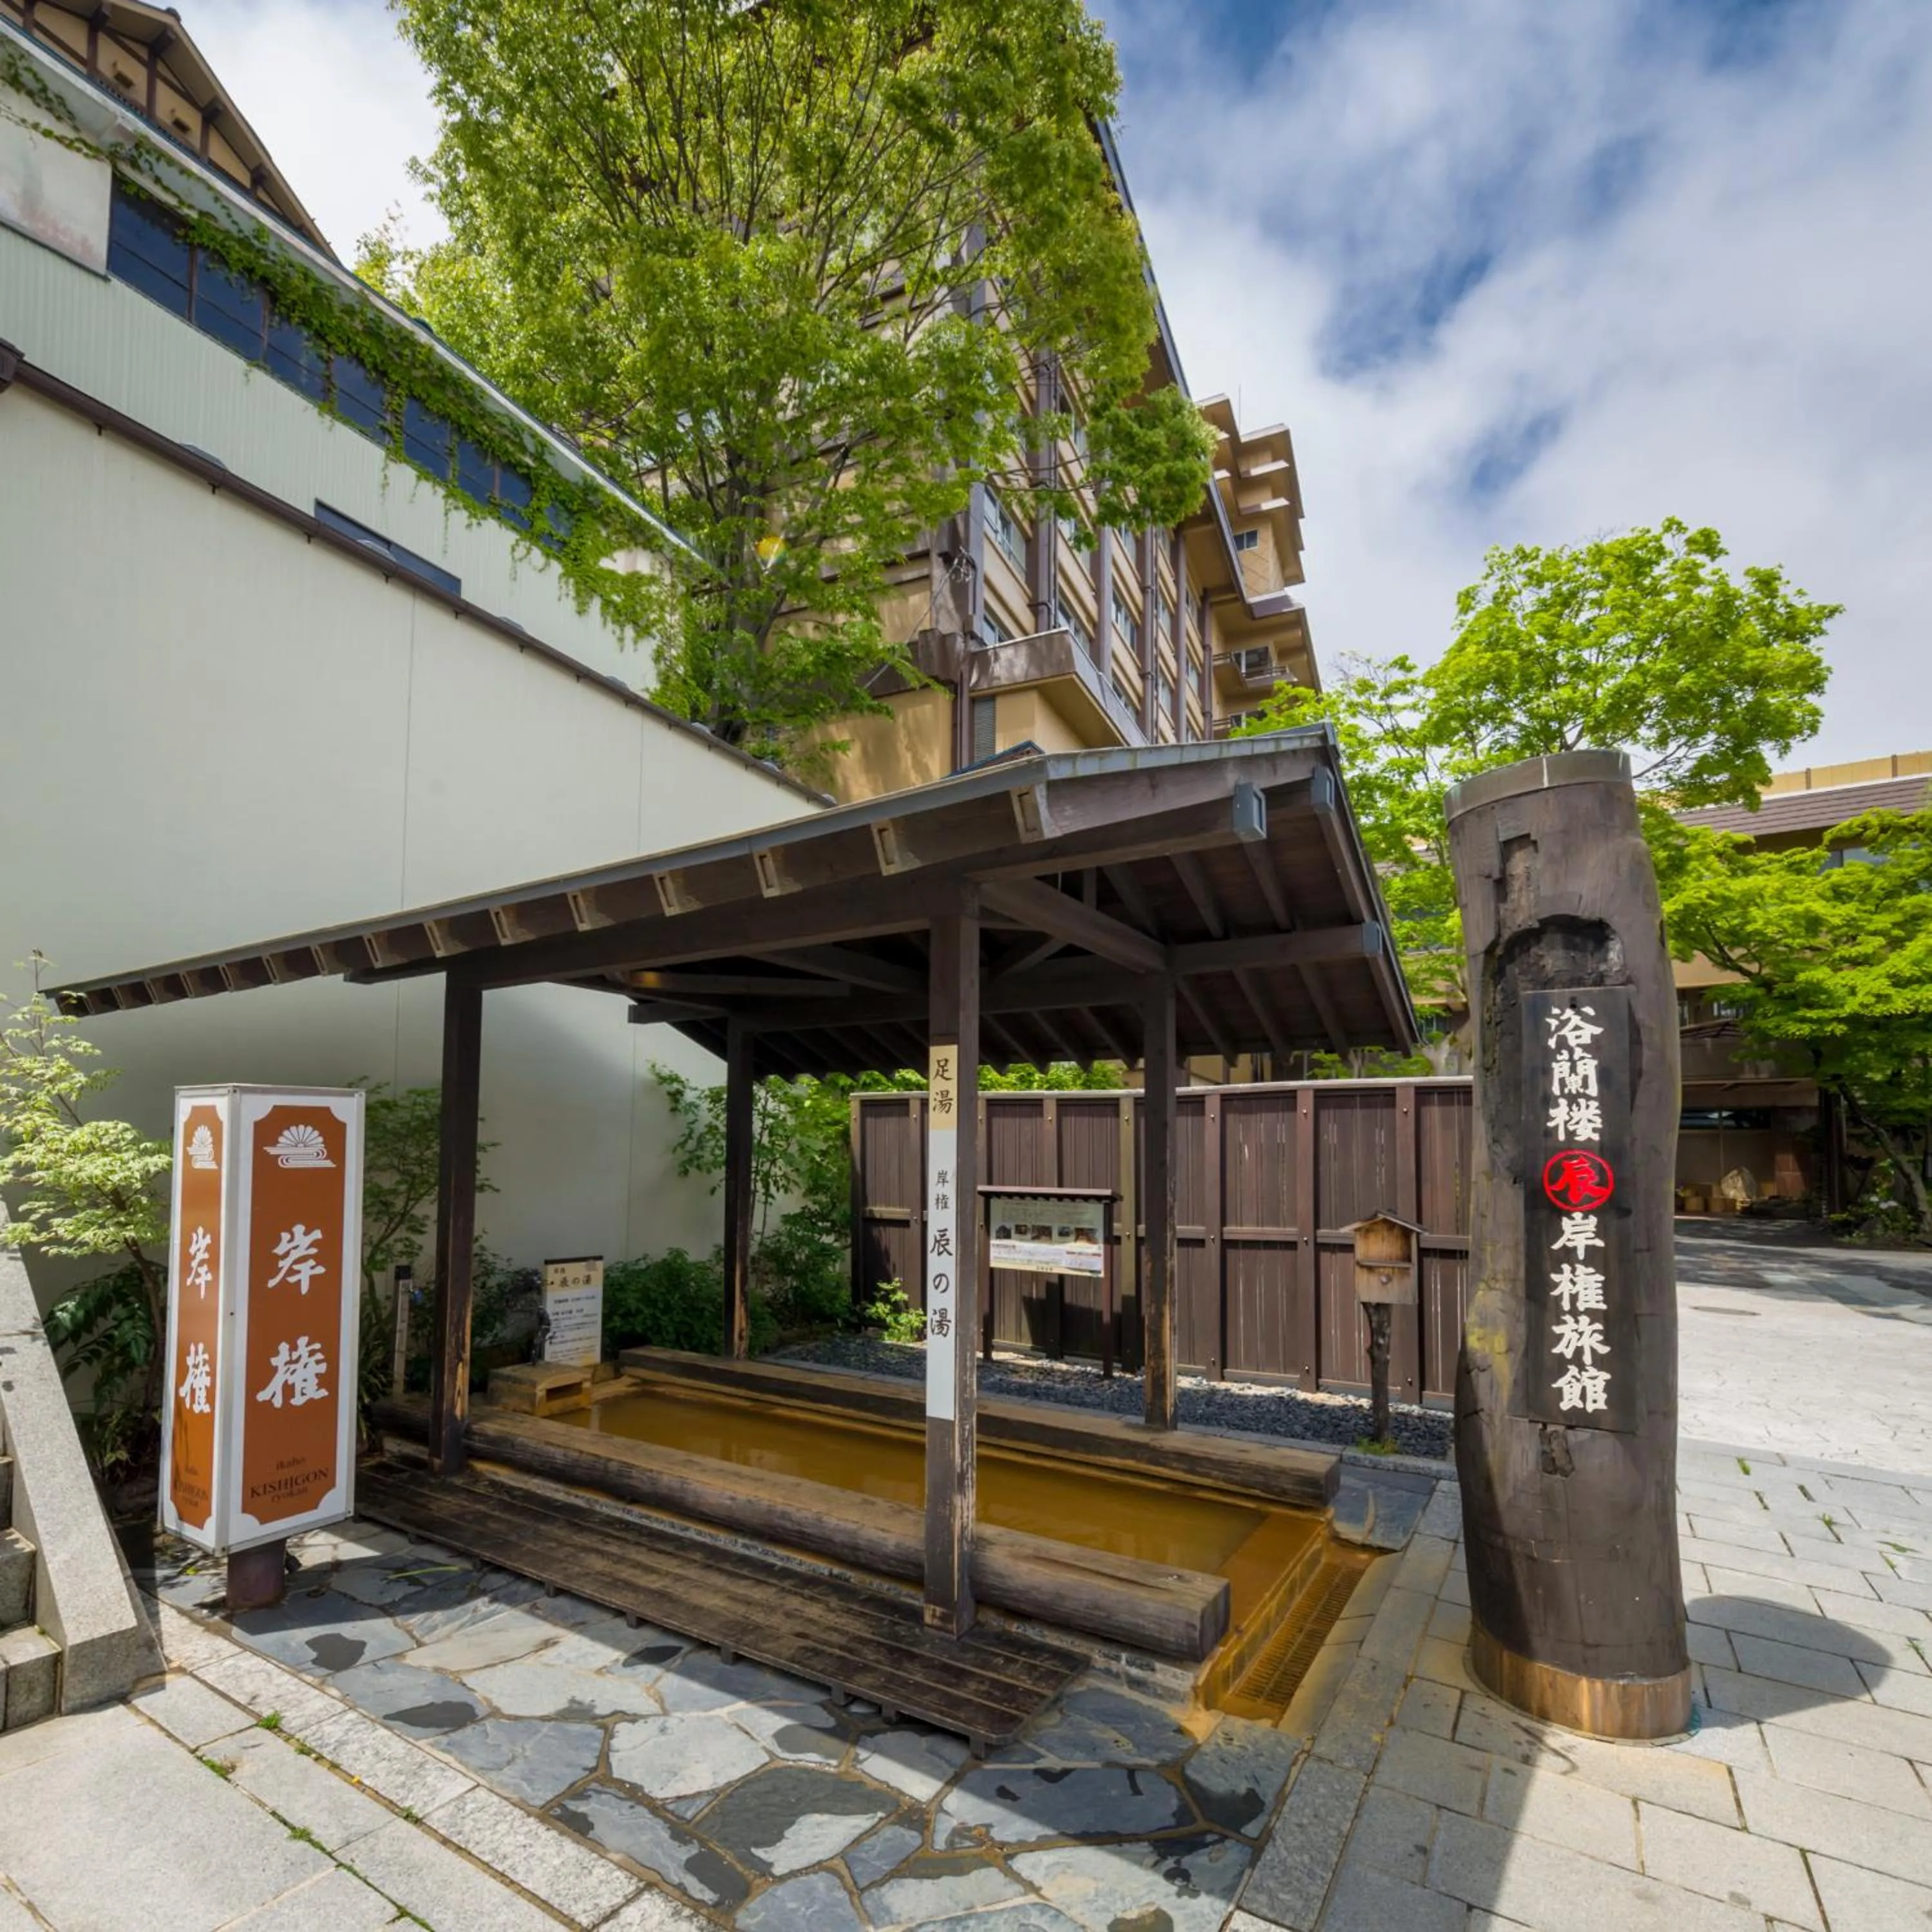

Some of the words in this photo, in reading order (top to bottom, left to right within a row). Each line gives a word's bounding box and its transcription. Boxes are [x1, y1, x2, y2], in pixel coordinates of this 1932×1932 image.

[933, 1057, 954, 1114] 足湯
[935, 1170, 949, 1211] 岸権
[929, 1227, 954, 1338] 辰の湯
[1550, 1212, 1612, 1414] 岸権旅館
[250, 1467, 329, 1498] KISHIGON
